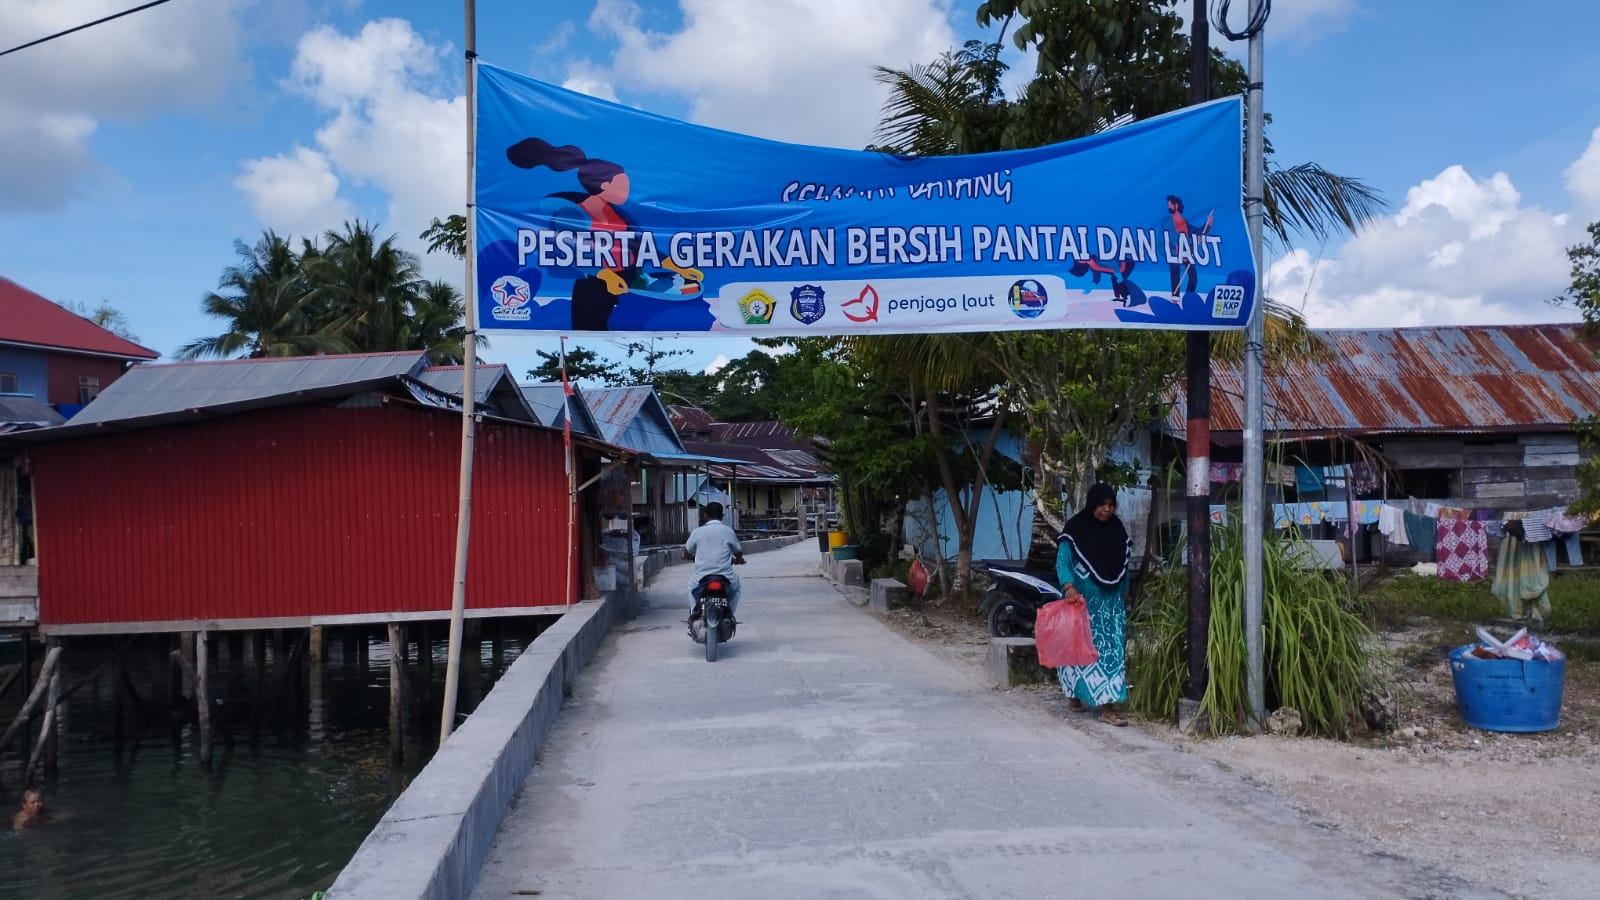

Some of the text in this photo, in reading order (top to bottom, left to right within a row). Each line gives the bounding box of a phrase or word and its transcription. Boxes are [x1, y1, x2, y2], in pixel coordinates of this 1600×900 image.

[518, 226, 1222, 268] PESERTA GERAKAN BERSIH PANTAI DAN LAUT
[888, 293, 996, 314] penjaga laut
[1216, 288, 1242, 301] 2022
